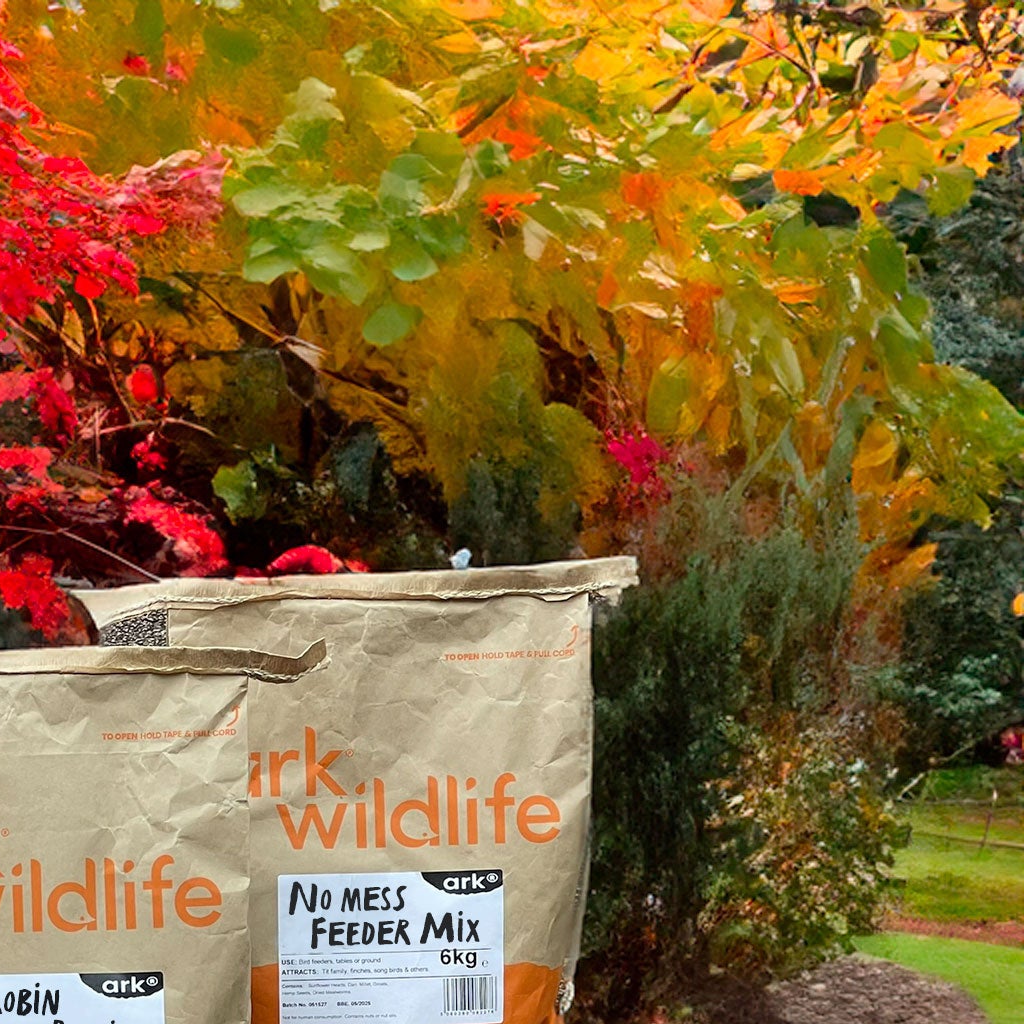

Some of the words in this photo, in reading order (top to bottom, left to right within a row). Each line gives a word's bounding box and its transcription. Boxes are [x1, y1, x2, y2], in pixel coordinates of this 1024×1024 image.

[457, 653, 479, 661] OPEN
[481, 652, 504, 660] HOLD
[505, 651, 525, 659] TAPE
[114, 732, 138, 740] OPEN
[212, 728, 237, 736] CORD
[276, 772, 561, 849] wildlife
[341, 886, 407, 912] MESS
[311, 917, 411, 949] FEEDER
[440, 948, 477, 968] 6kg
